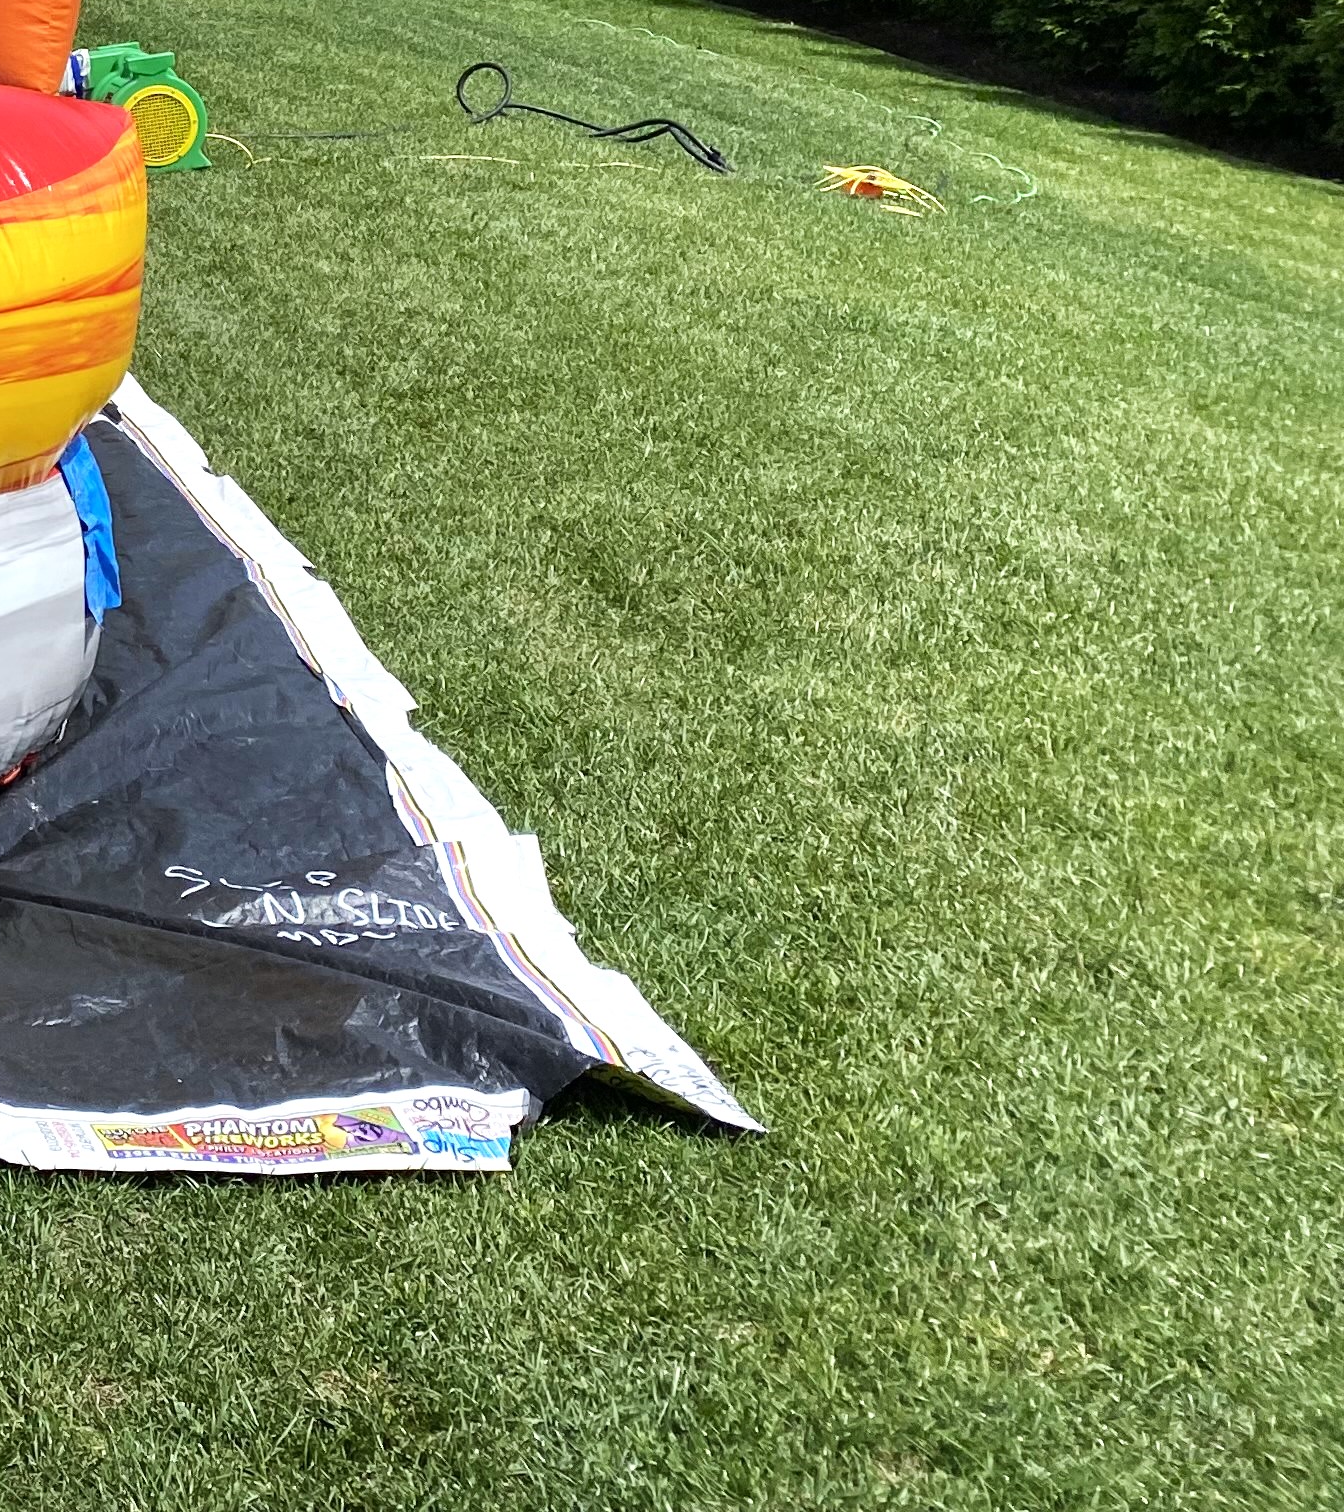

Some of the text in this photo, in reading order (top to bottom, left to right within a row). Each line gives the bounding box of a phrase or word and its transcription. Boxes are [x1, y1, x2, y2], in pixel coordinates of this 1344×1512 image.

[262, 890, 305, 925] N
[337, 887, 461, 931] SLIDE
[413, 1096, 490, 1122] Combo
[184, 1118, 317, 1137] PHANTOM
[190, 1132, 325, 1149] FIREWORKS
[423, 1139, 480, 1163] Slip
